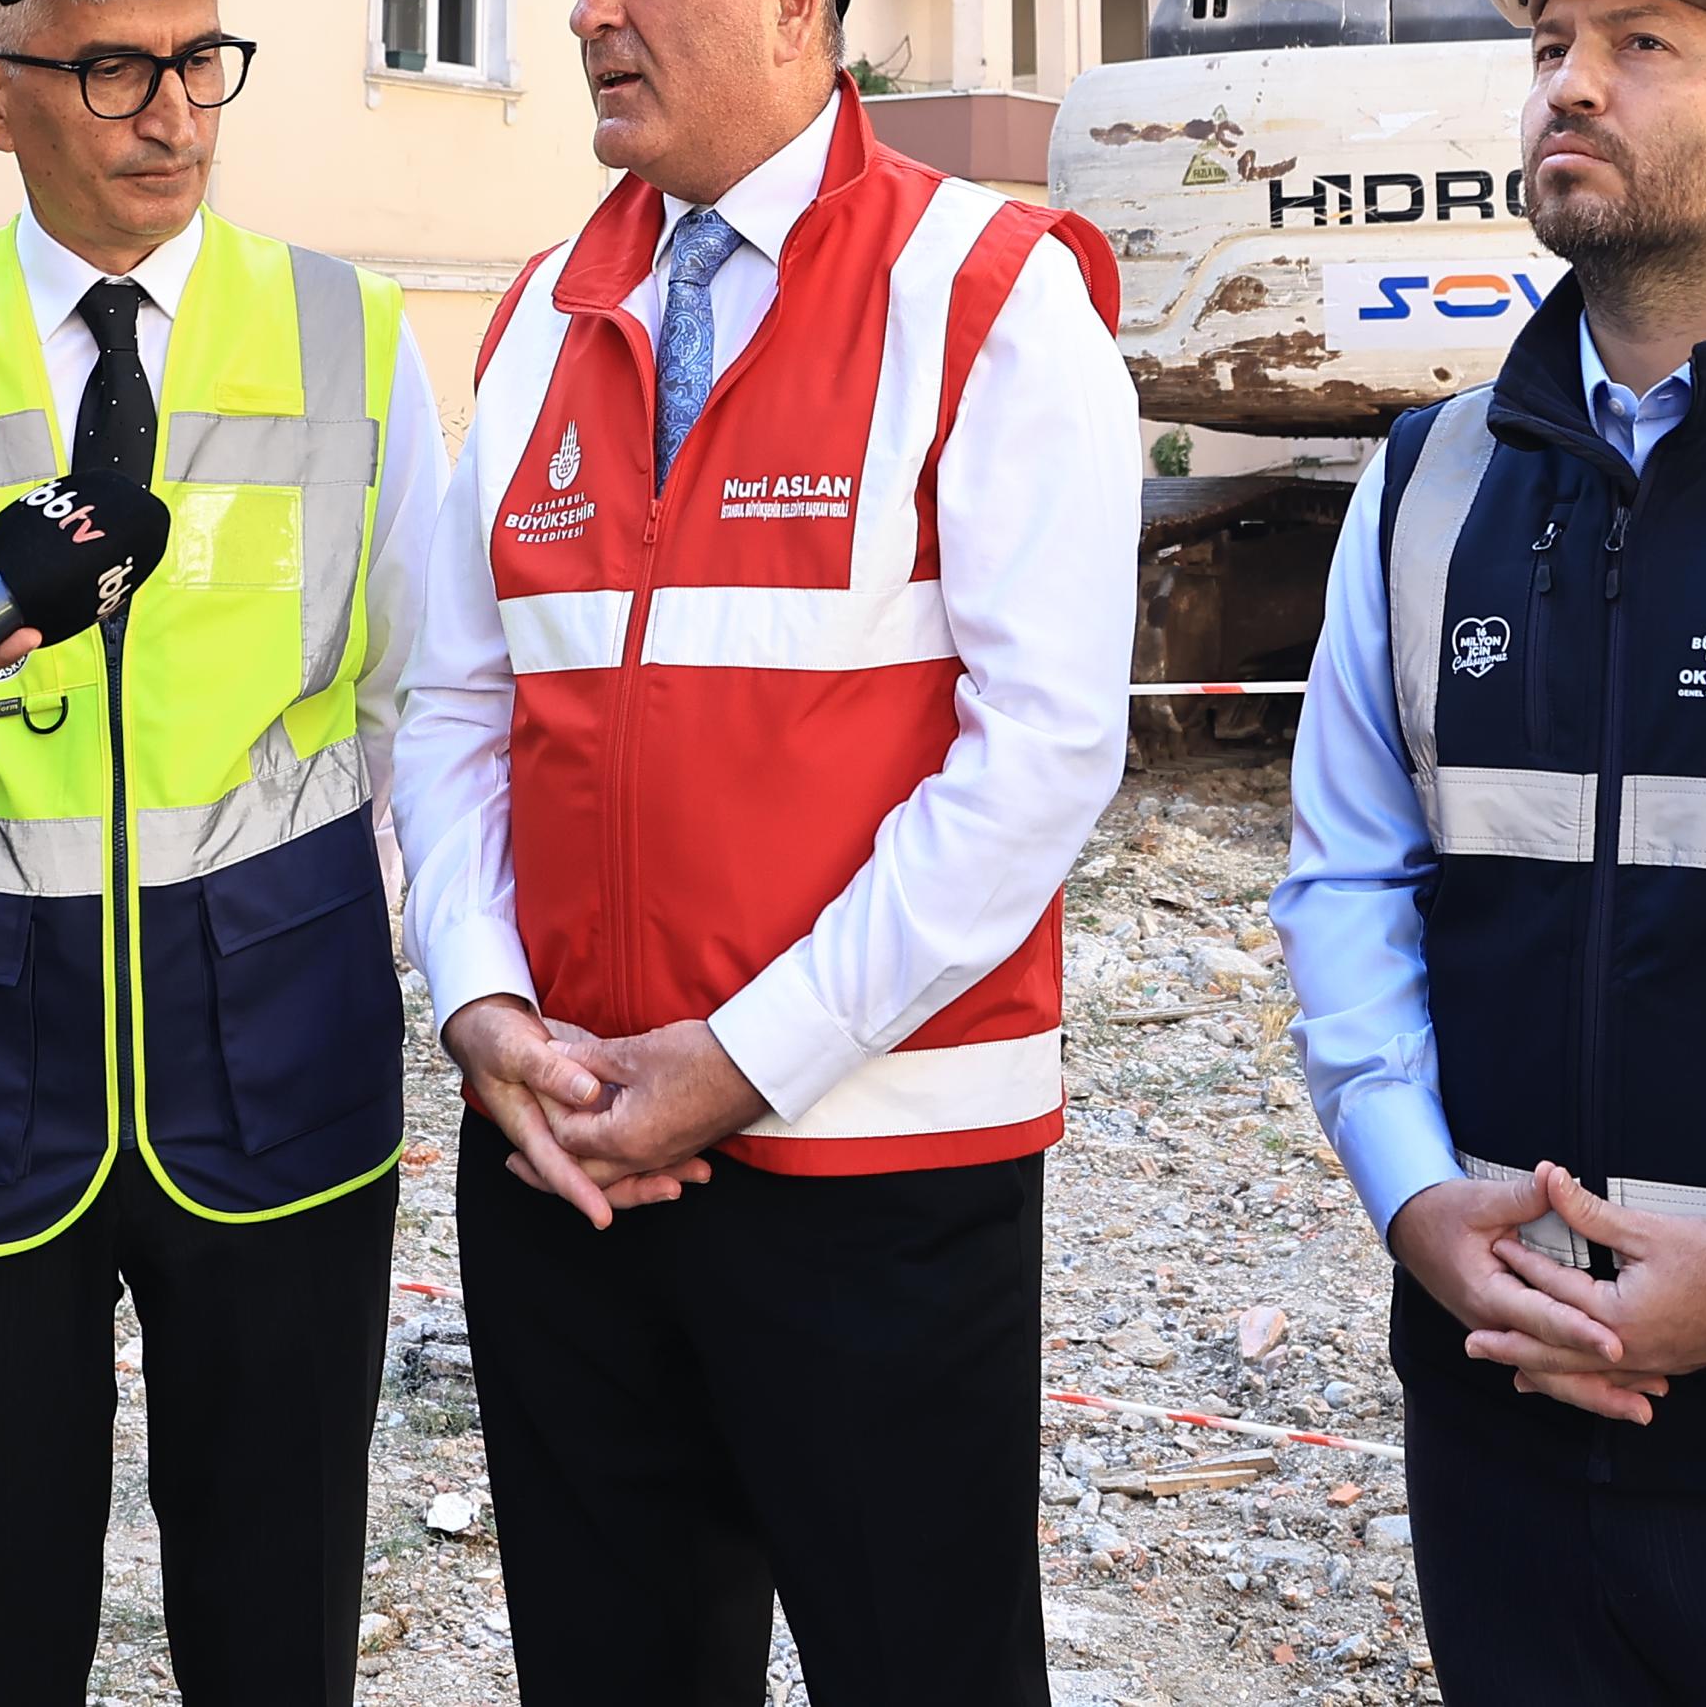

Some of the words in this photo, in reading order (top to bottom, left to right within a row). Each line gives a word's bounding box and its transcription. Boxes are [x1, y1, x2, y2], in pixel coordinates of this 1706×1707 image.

[1269, 169, 1527, 229] HIDR
[723, 476, 768, 500] Nuri
[772, 475, 852, 497] ASLAN
[530, 491, 585, 513] İSTANBUL
[504, 501, 596, 531] BÜYÜKŞEHİR
[517, 524, 584, 543] BELEDİYESİ
[1460, 635, 1501, 648] MİLYON
[1475, 627, 1487, 637] 16
[1678, 689, 1704, 698] GENEL
